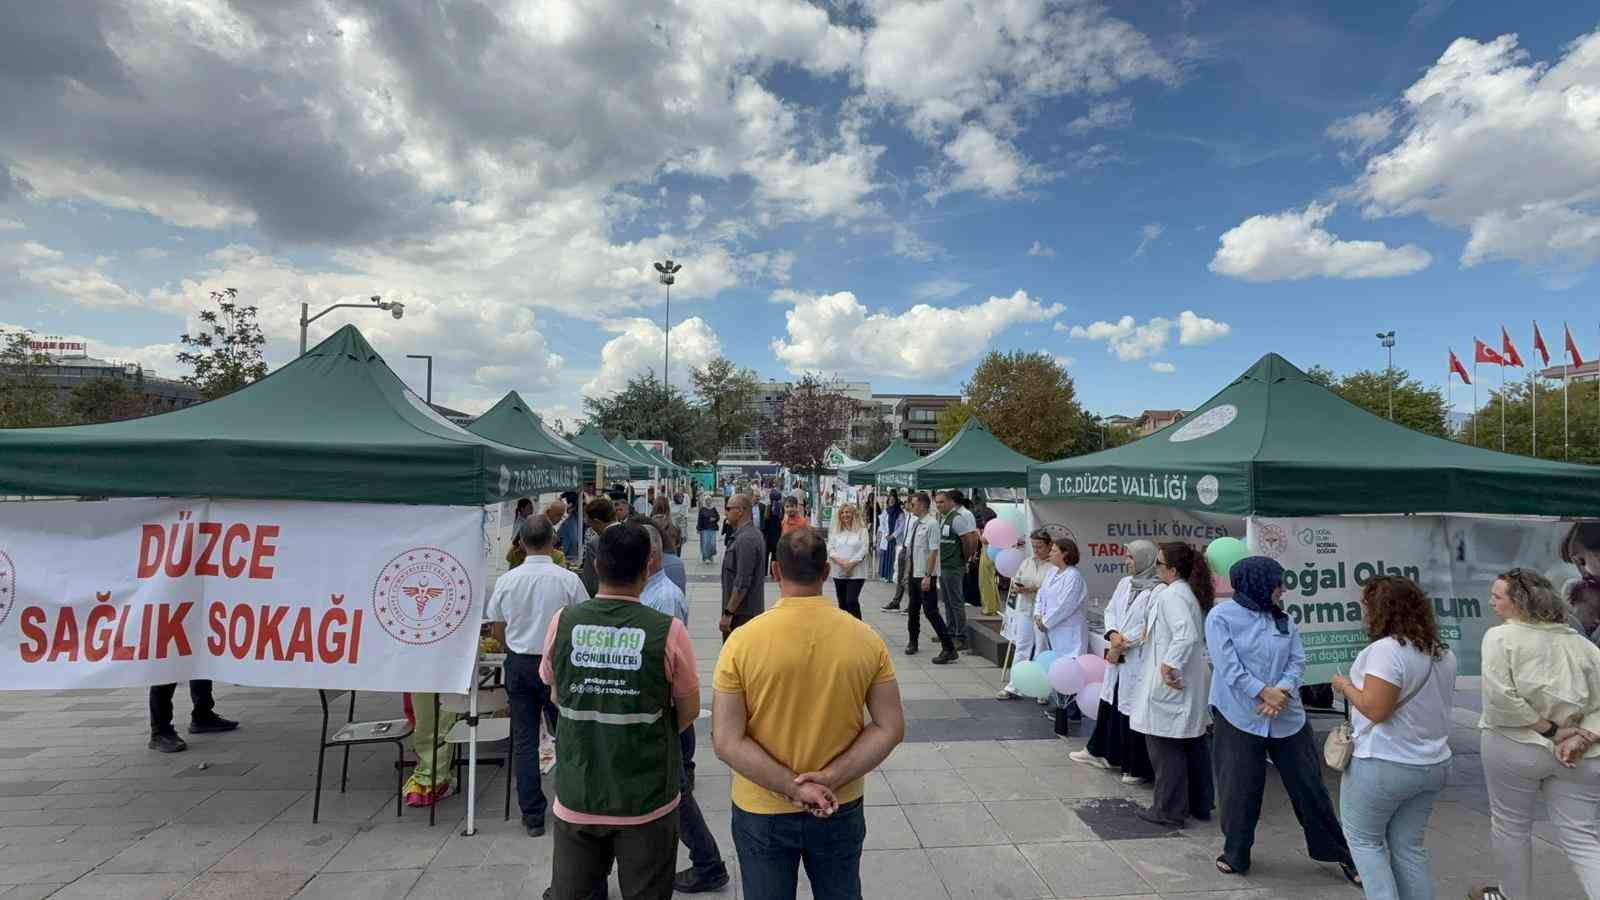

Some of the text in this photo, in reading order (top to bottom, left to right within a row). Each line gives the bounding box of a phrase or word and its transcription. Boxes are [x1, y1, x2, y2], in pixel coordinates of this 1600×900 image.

[59, 342, 82, 350] OTEL
[1121, 474, 1188, 500] VALİLİĞİ
[1107, 520, 1168, 537] EVLİLİK
[137, 511, 280, 579] DÜZCE
[1282, 562, 1346, 596] oğal
[1281, 600, 1361, 624] orma
[19, 591, 194, 663] SAĞLIK
[207, 594, 363, 664] SOKAĞI
